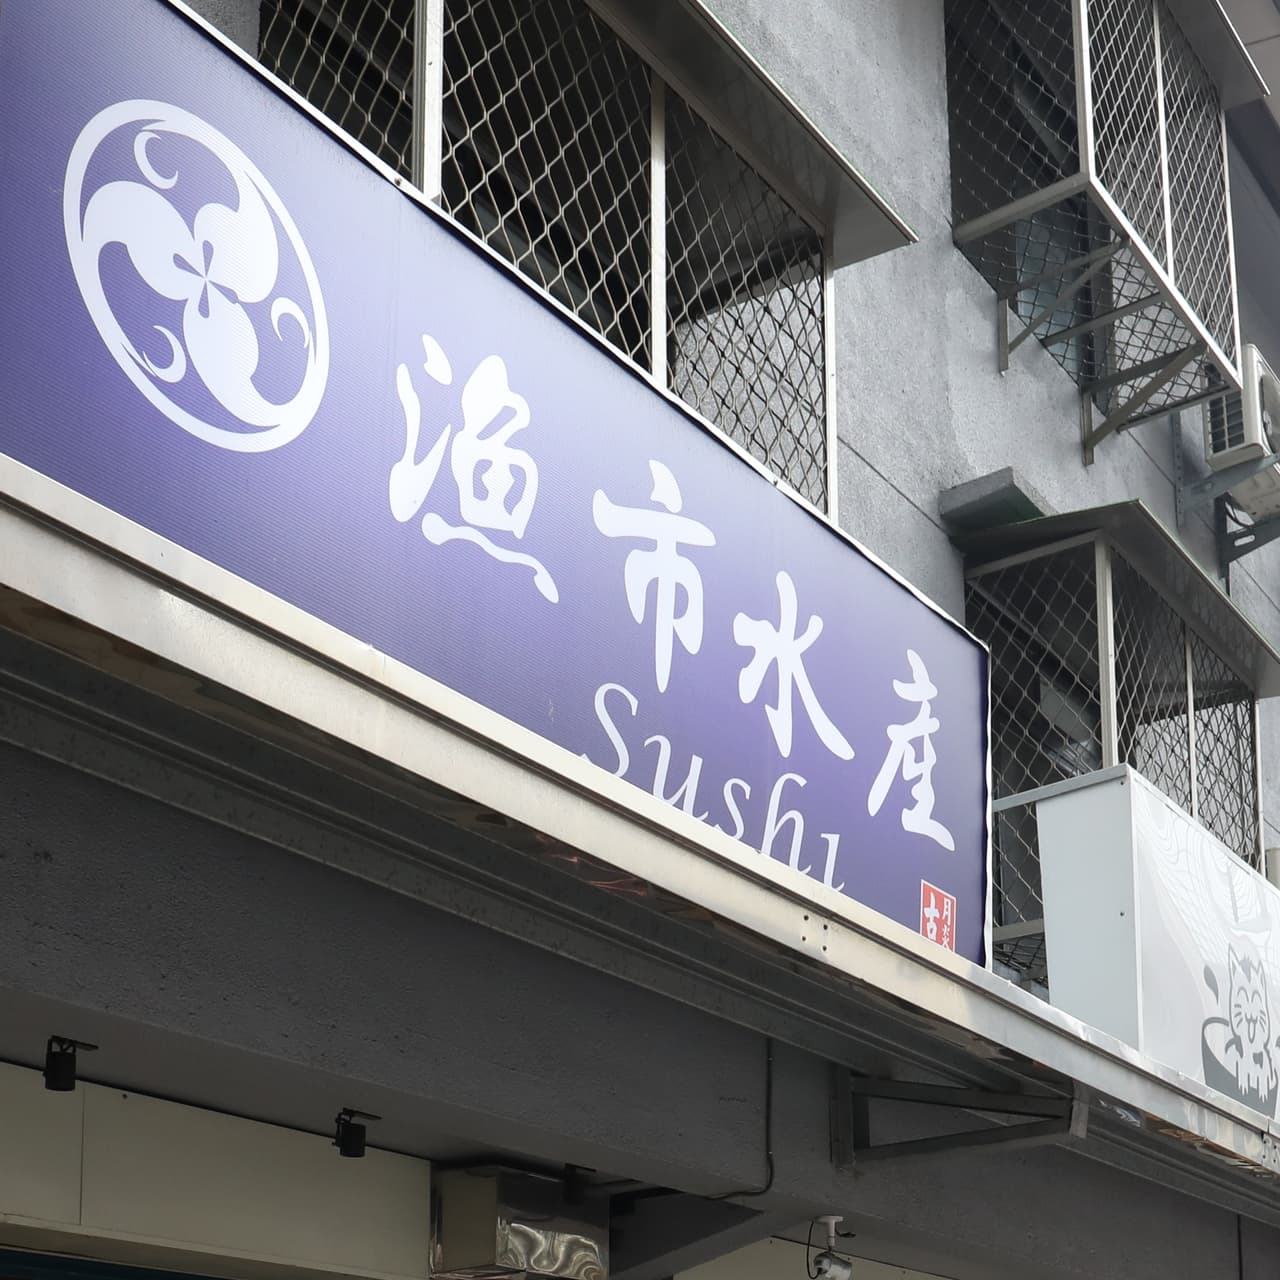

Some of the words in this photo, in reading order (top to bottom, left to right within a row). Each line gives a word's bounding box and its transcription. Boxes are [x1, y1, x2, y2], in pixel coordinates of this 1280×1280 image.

[388, 334, 955, 852] 漁市水產
[578, 682, 846, 891] Sushi
